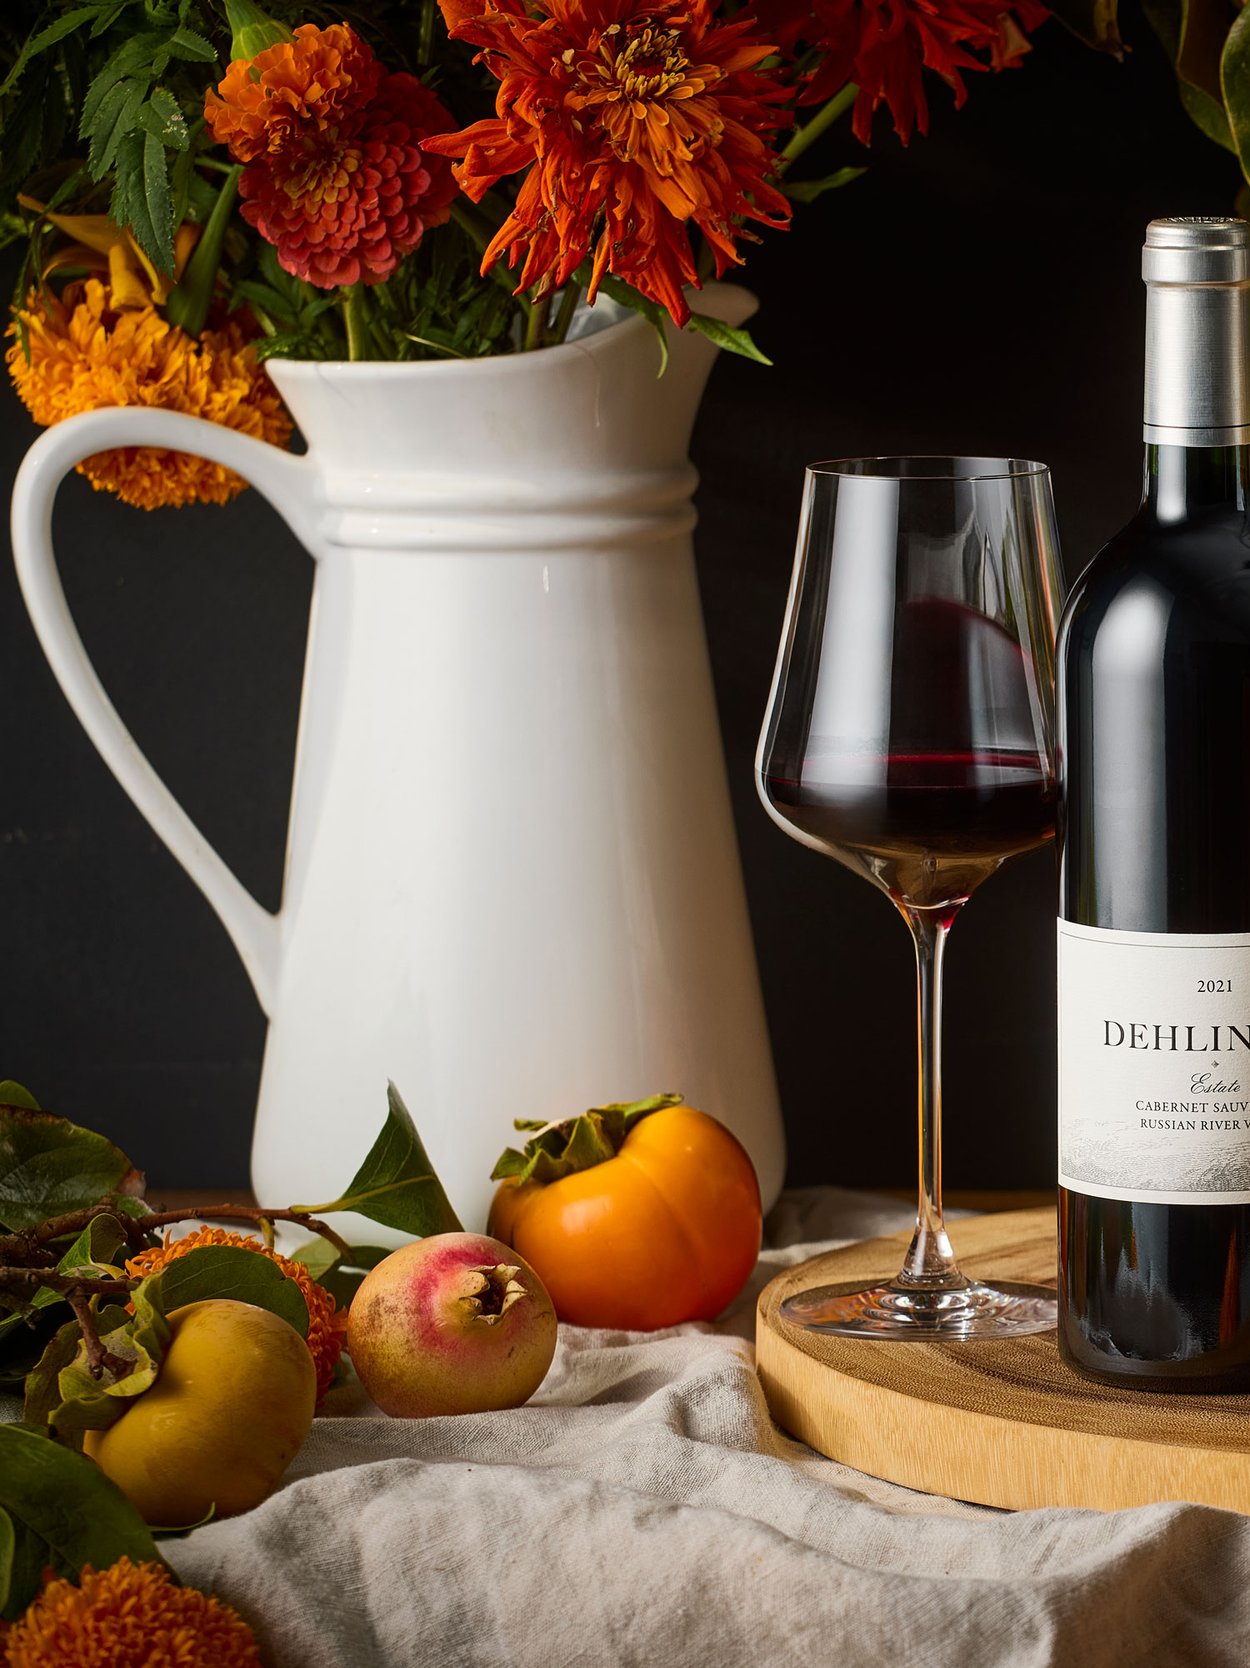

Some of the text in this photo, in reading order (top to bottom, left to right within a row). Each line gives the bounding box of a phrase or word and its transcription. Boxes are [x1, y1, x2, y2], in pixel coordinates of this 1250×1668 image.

[1197, 980, 1233, 993] 2021
[1190, 1072, 1241, 1095] Estate
[1135, 1100, 1209, 1113] CABERNET
[1140, 1118, 1196, 1130] RUSSIAN
[1200, 1118, 1241, 1131] RIVER
